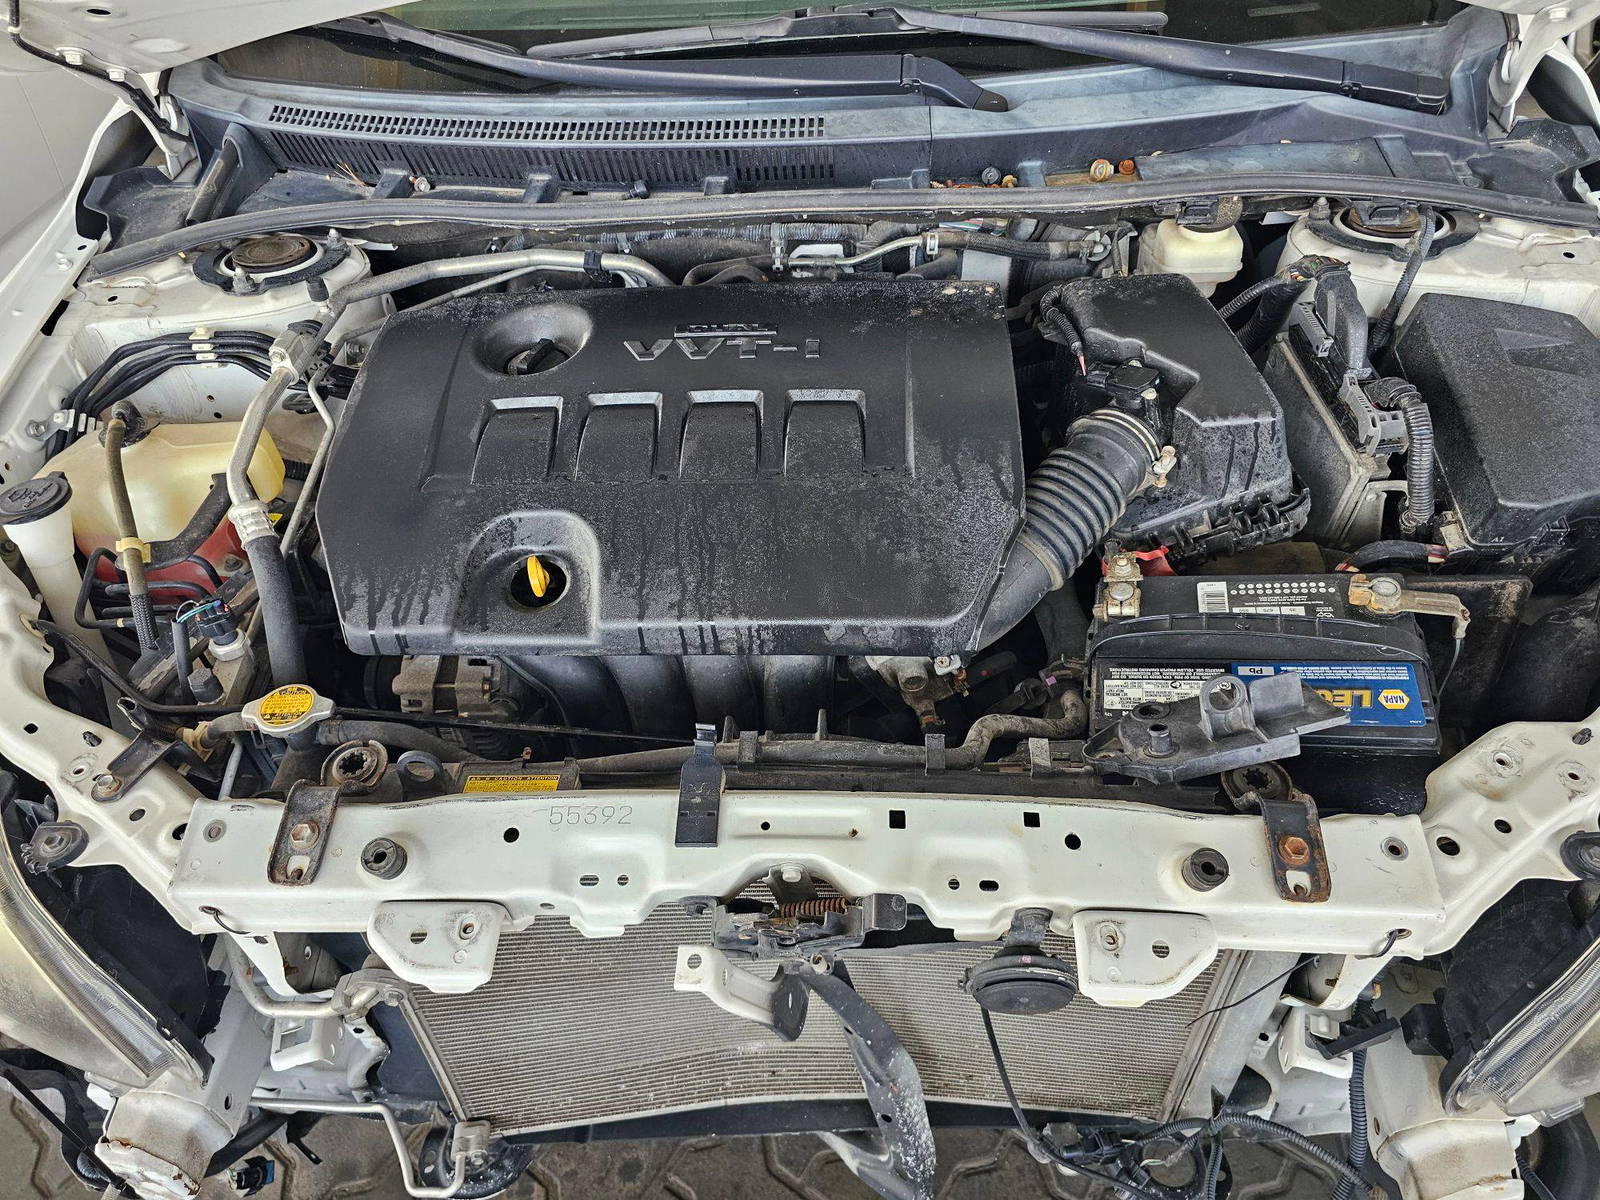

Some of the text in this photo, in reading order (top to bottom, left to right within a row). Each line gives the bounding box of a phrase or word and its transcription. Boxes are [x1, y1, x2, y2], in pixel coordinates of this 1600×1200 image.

[1249, 667, 1263, 675] Pb
[1383, 694, 1405, 704] NAPA
[549, 805, 633, 825] 55392
